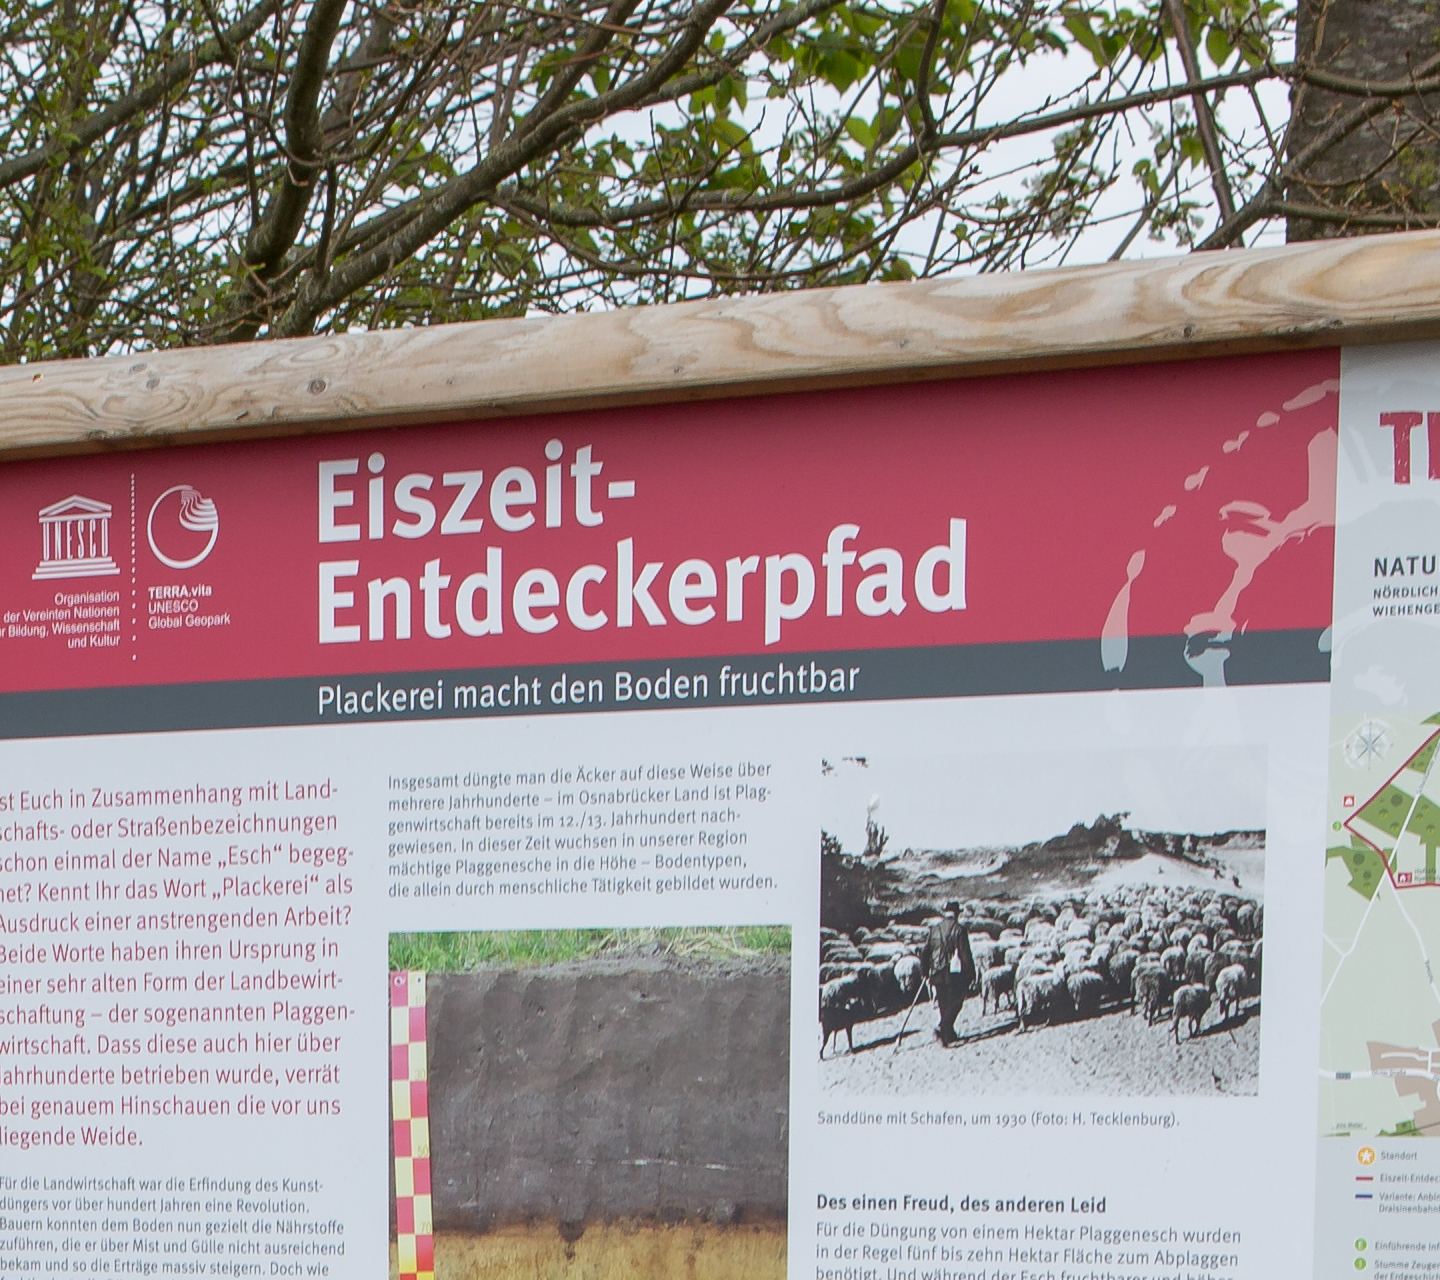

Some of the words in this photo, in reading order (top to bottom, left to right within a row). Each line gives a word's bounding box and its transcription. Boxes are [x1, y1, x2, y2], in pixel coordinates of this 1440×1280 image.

[319, 438, 636, 543] Eiszeit-
[148, 583, 212, 600] TERRA.vita
[319, 517, 968, 646] Entdeckerpfad
[54, 589, 120, 608] Organisation
[148, 599, 199, 615] UNESCO
[3, 610, 21, 624] der
[22, 607, 71, 623] Vereinten
[73, 605, 120, 619] Nationen
[148, 614, 183, 630] Global
[185, 611, 231, 629] Geopark
[8, 623, 49, 639] Bildung,
[51, 619, 121, 637] Wissenschaft
[67, 634, 87, 649] und
[89, 633, 121, 648] Kultur
[318, 679, 443, 715] Plackerei
[454, 672, 540, 712] macht
[550, 671, 606, 706] den
[614, 668, 708, 703] Boden
[718, 661, 861, 697] fruchtbar
[388, 773, 459, 793] Insgesamt
[463, 771, 512, 789] düngte
[516, 772, 546, 785] man
[550, 768, 572, 784] die
[575, 765, 616, 783] Äcker
[619, 765, 643, 782] auf
[646, 764, 686, 781] diese
[689, 762, 733, 779] Weise
[738, 761, 772, 778] über
[20, 788, 63, 811] Euch
[69, 788, 85, 809] in
[91, 782, 243, 808] Zusammenhang
[249, 780, 279, 802] mit
[285, 777, 338, 801] Land-
[70, 818, 113, 840] oder
[117, 811, 337, 838] Straßenbezeichnungen
[54, 848, 116, 871] einmal
[122, 847, 153, 869] der
[158, 847, 212, 868] Name
[218, 843, 282, 869] „Esch“
[289, 842, 354, 868] begeg-
[38, 882, 90, 902] Kennt
[96, 879, 120, 901] Ihr
[125, 879, 158, 900] das
[163, 878, 206, 899] Wort
[212, 873, 319, 901] „Plackerei“
[325, 872, 353, 895] als
[84, 910, 132, 932] einer
[136, 906, 278, 933] anstrengenden
[284, 905, 352, 927] Arbeit?
[51, 943, 105, 963] Worte
[111, 940, 168, 962] haben
[175, 939, 222, 961] ihren
[229, 939, 316, 964] Ursprung
[322, 936, 338, 958] in
[47, 972, 87, 994] sehr
[91, 972, 137, 993] alten
[144, 972, 188, 992] Form
[194, 970, 225, 992] der
[231, 968, 343, 991] Landbewirt-
[817, 1110, 883, 1125] Sanddüne
[886, 1111, 907, 1125] mit
[910, 1111, 967, 1127] Schafen,
[971, 1114, 991, 1125] um
[996, 1114, 1027, 1129] 1930
[1031, 1110, 1068, 1127] (Foto:
[1072, 1111, 1086, 1126] H.
[1090, 1111, 1180, 1129] Tecklenburg).
[817, 1193, 847, 1210] Des
[852, 1193, 897, 1211] einen
[903, 1194, 955, 1214] Freud,
[960, 1194, 990, 1212] des
[995, 1195, 1065, 1213] anderen
[1071, 1196, 1106, 1214] Leid
